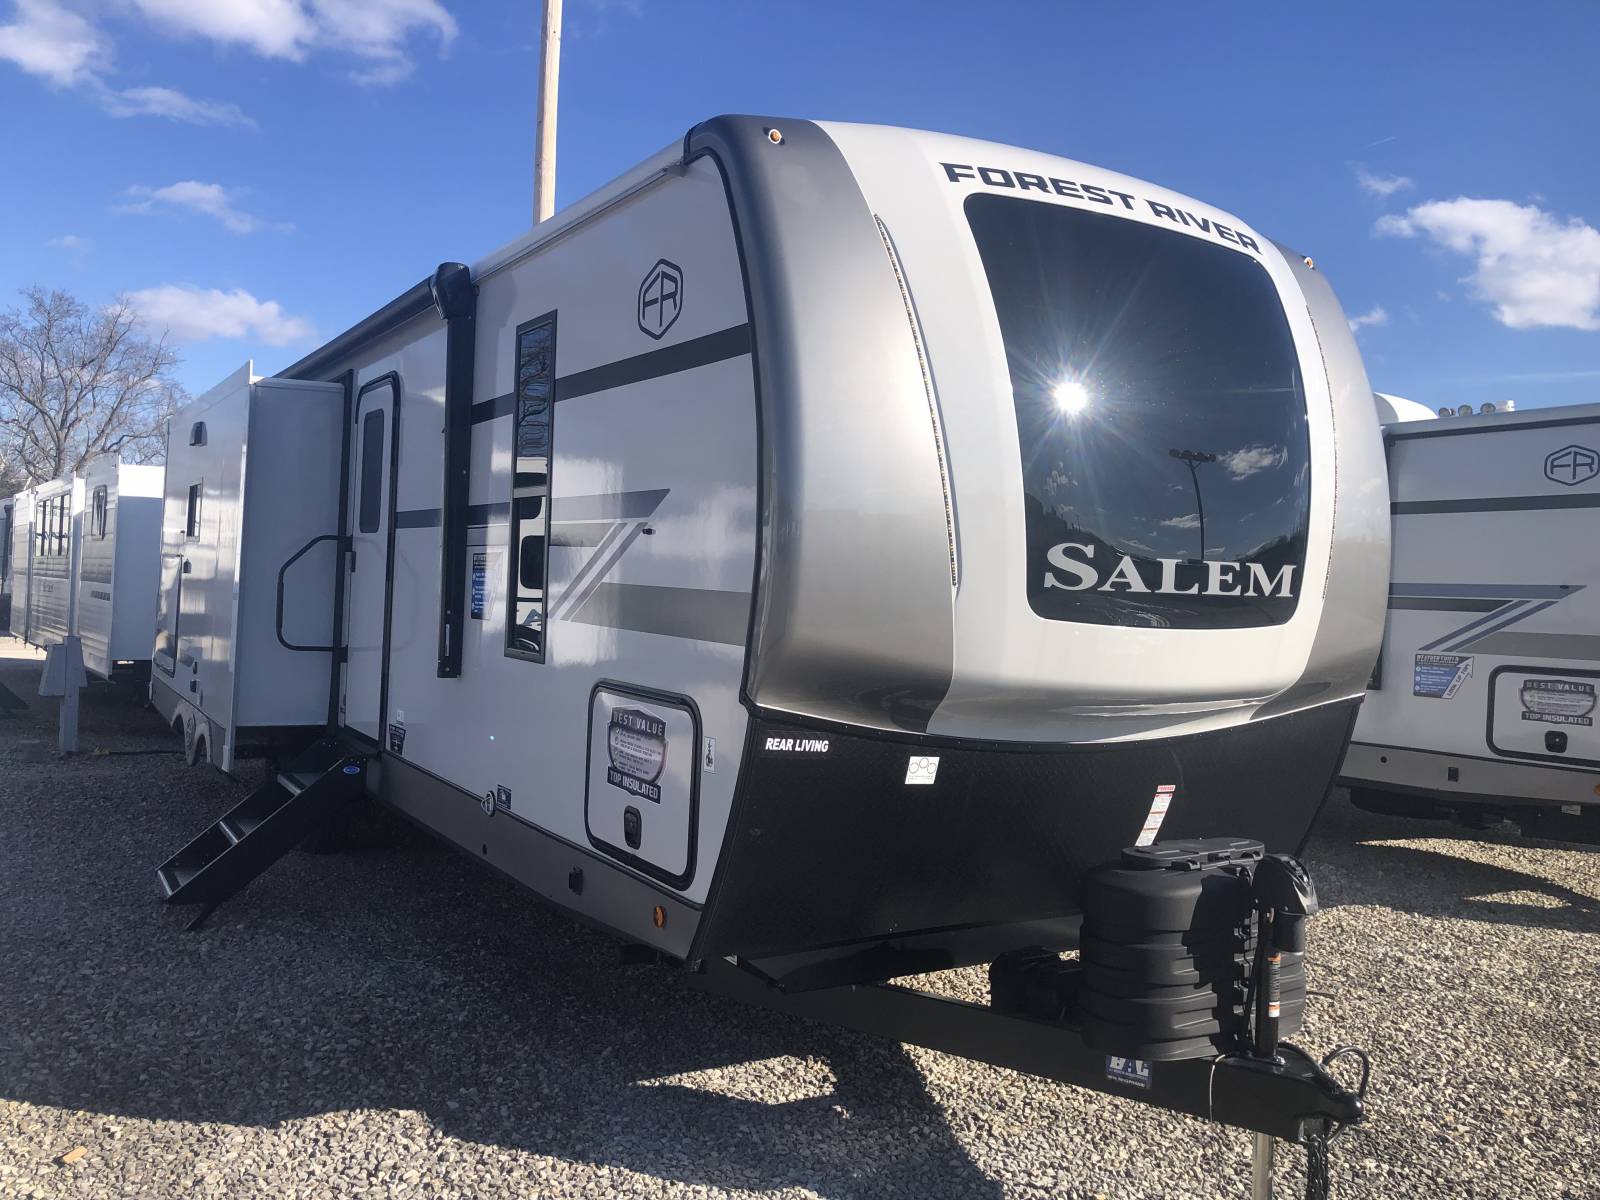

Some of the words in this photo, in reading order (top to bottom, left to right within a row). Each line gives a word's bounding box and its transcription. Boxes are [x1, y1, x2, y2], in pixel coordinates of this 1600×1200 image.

[940, 162, 1139, 211] FOREST
[1143, 197, 1263, 255] RIVER
[1558, 683, 1592, 693] VALUE
[613, 711, 634, 727] BEST
[636, 718, 664, 736] VALUE
[1542, 714, 1591, 725] INSULATED
[765, 737, 794, 751] REAR
[795, 739, 830, 753] LIVING
[609, 770, 622, 783] TOP
[622, 775, 659, 799] INSULATED
